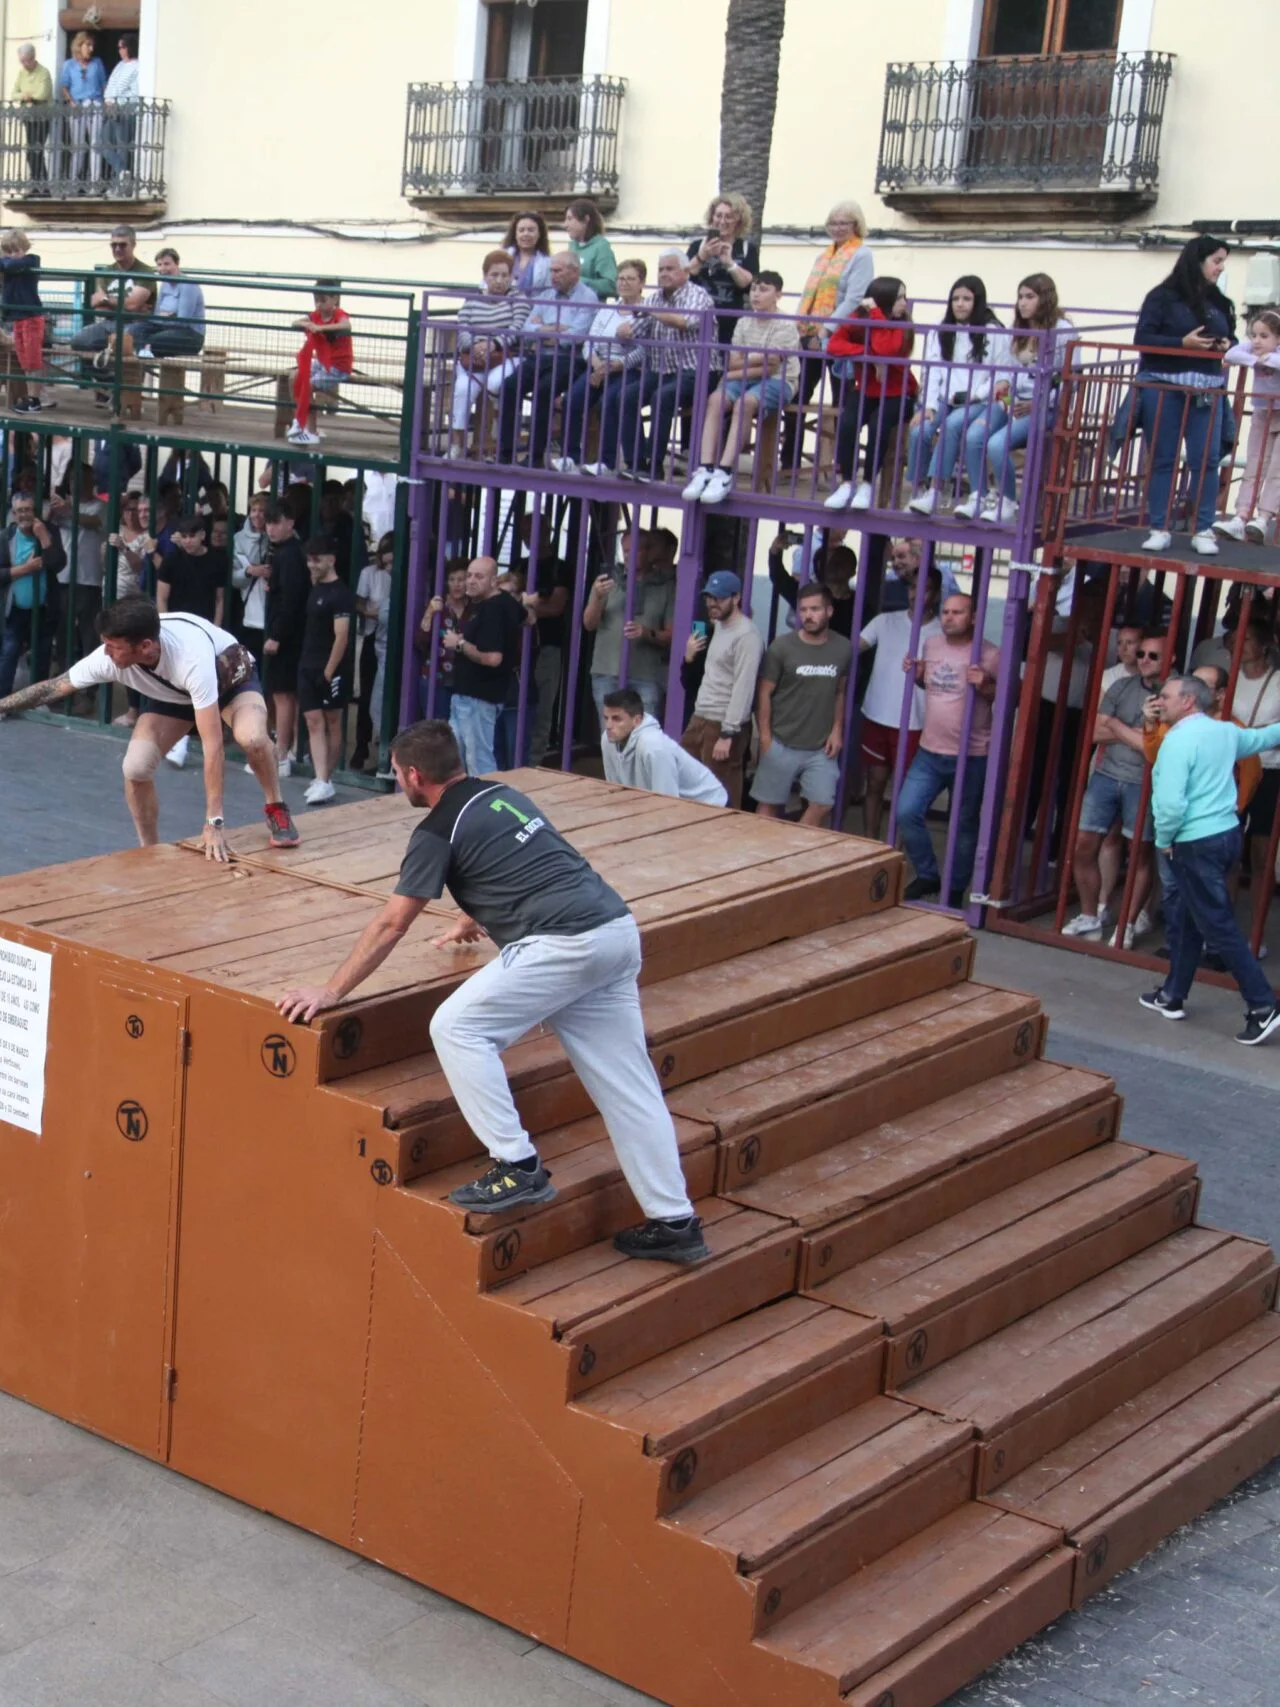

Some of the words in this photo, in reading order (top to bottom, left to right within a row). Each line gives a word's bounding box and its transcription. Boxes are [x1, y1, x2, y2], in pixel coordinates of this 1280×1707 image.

[489, 798, 530, 825] 7
[515, 831, 529, 843] EL
[357, 1137, 366, 1158] 1
